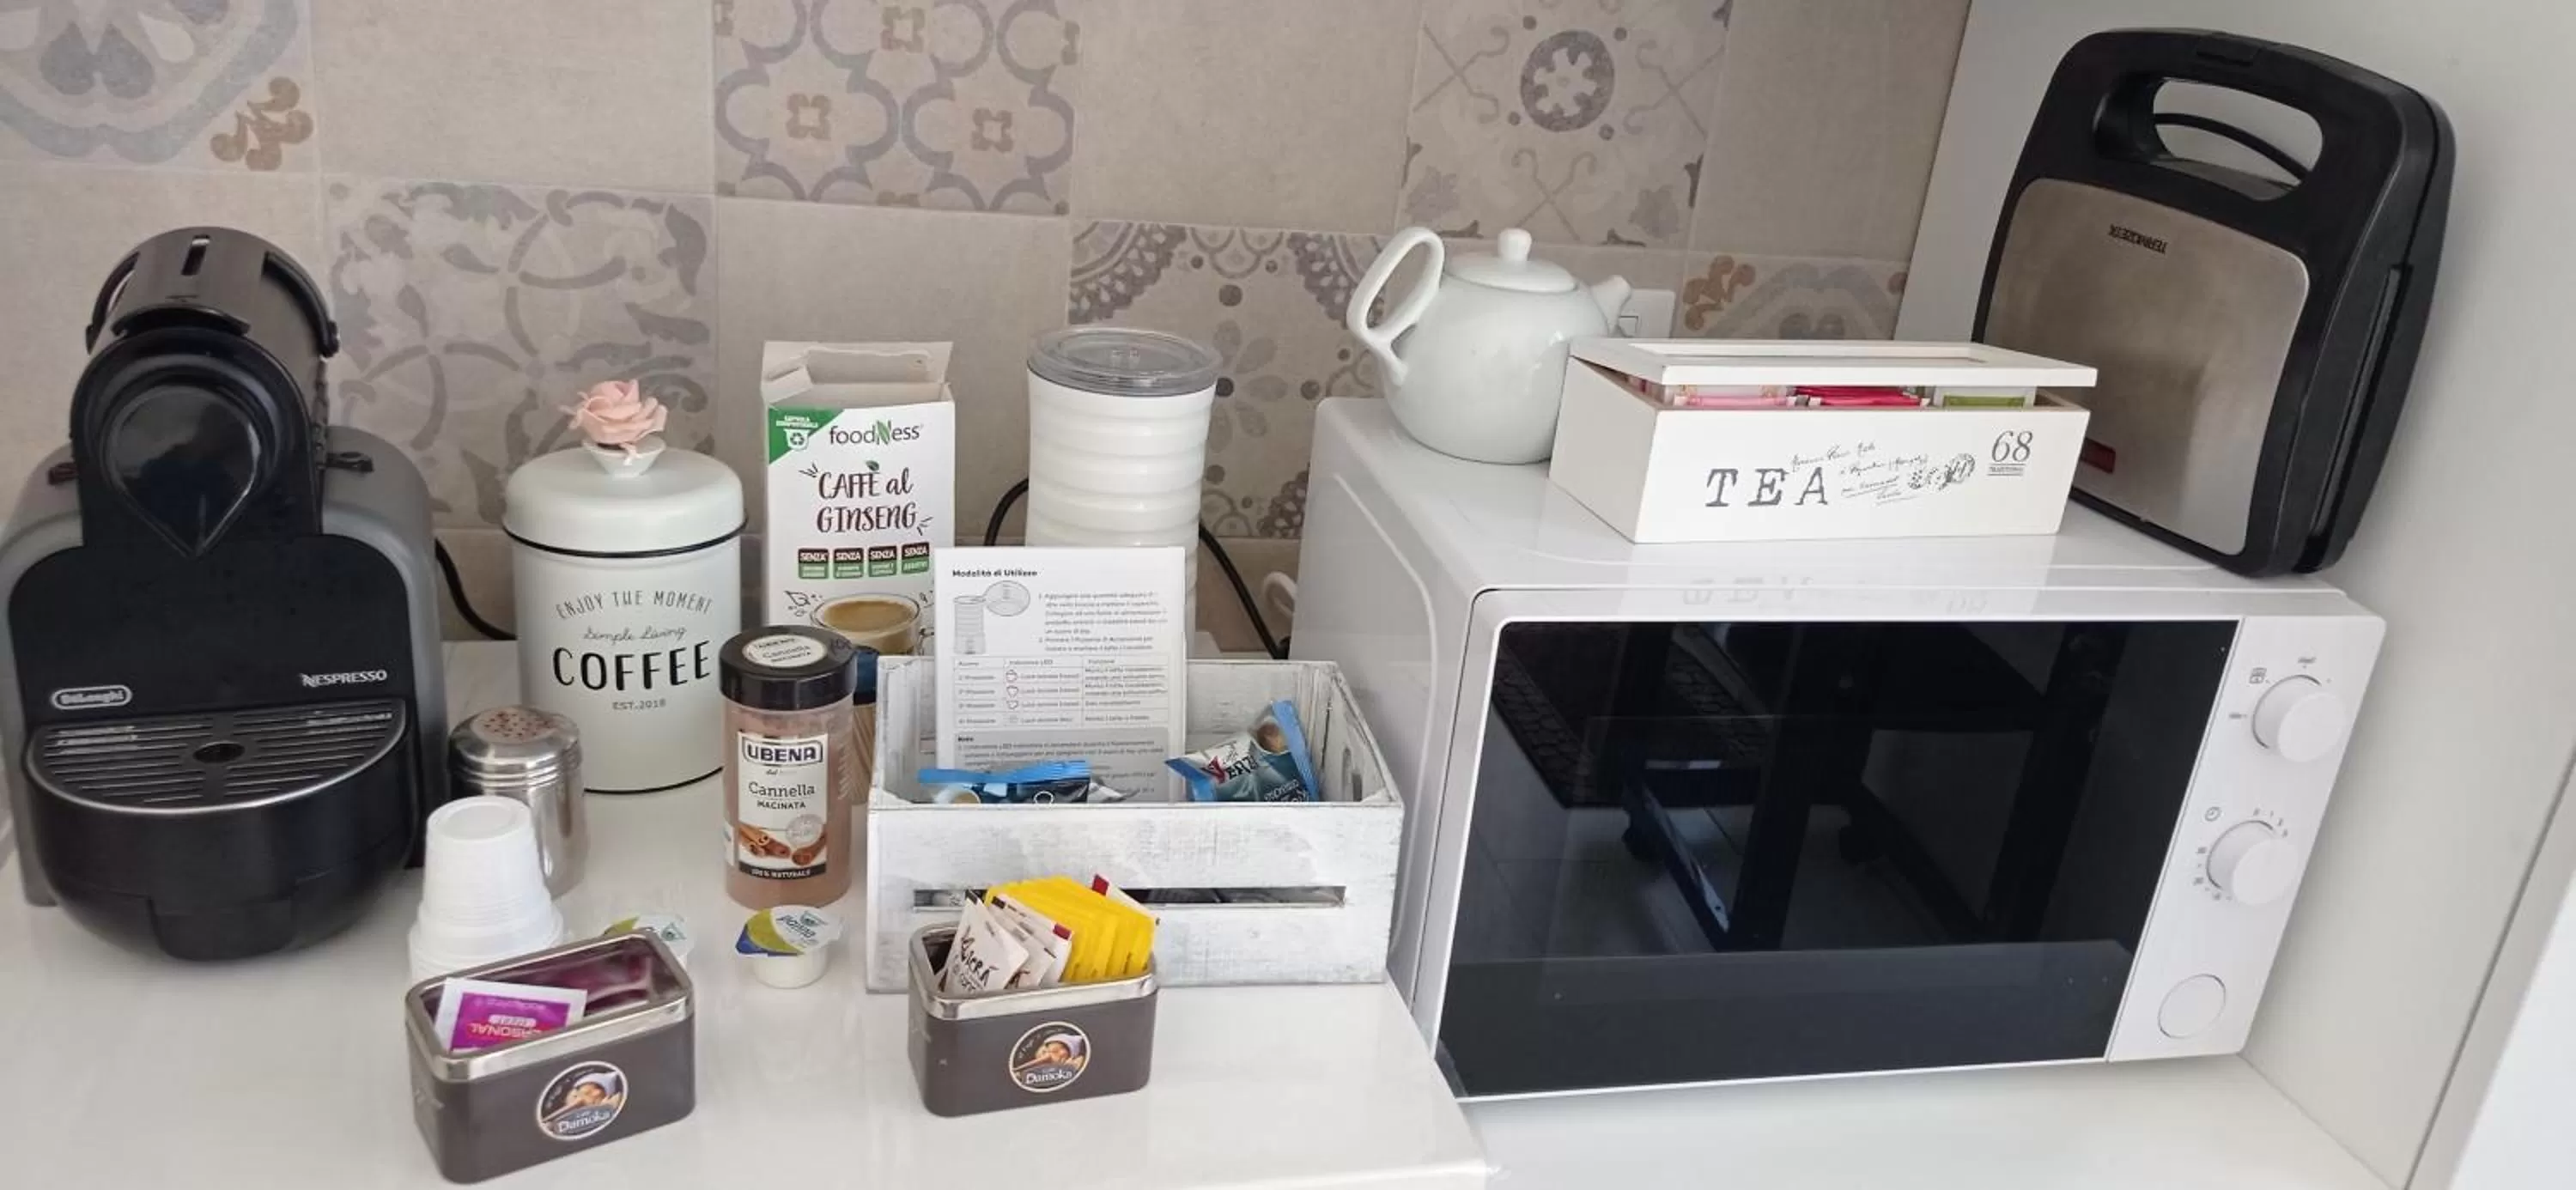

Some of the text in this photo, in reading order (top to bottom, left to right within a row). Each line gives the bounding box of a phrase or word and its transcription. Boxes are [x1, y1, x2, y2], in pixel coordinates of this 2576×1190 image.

[1991, 430, 2033, 462] 68
[1704, 466, 1829, 507] TEA
[816, 501, 917, 533] GINSENG
[799, 552, 827, 562] SENZA
[835, 552, 861, 561] SENZA
[870, 550, 895, 560] SENZA
[904, 546, 927, 557] SENZA
[556, 591, 714, 619] ENJOY THE MOMENT
[583, 626, 635, 645] Simple
[552, 641, 711, 691] COFFEE
[300, 670, 387, 687] NESPRESSO
[747, 744, 817, 762] UBENA
[748, 781, 815, 798] Cannella
[756, 800, 806, 810] MACINATA
